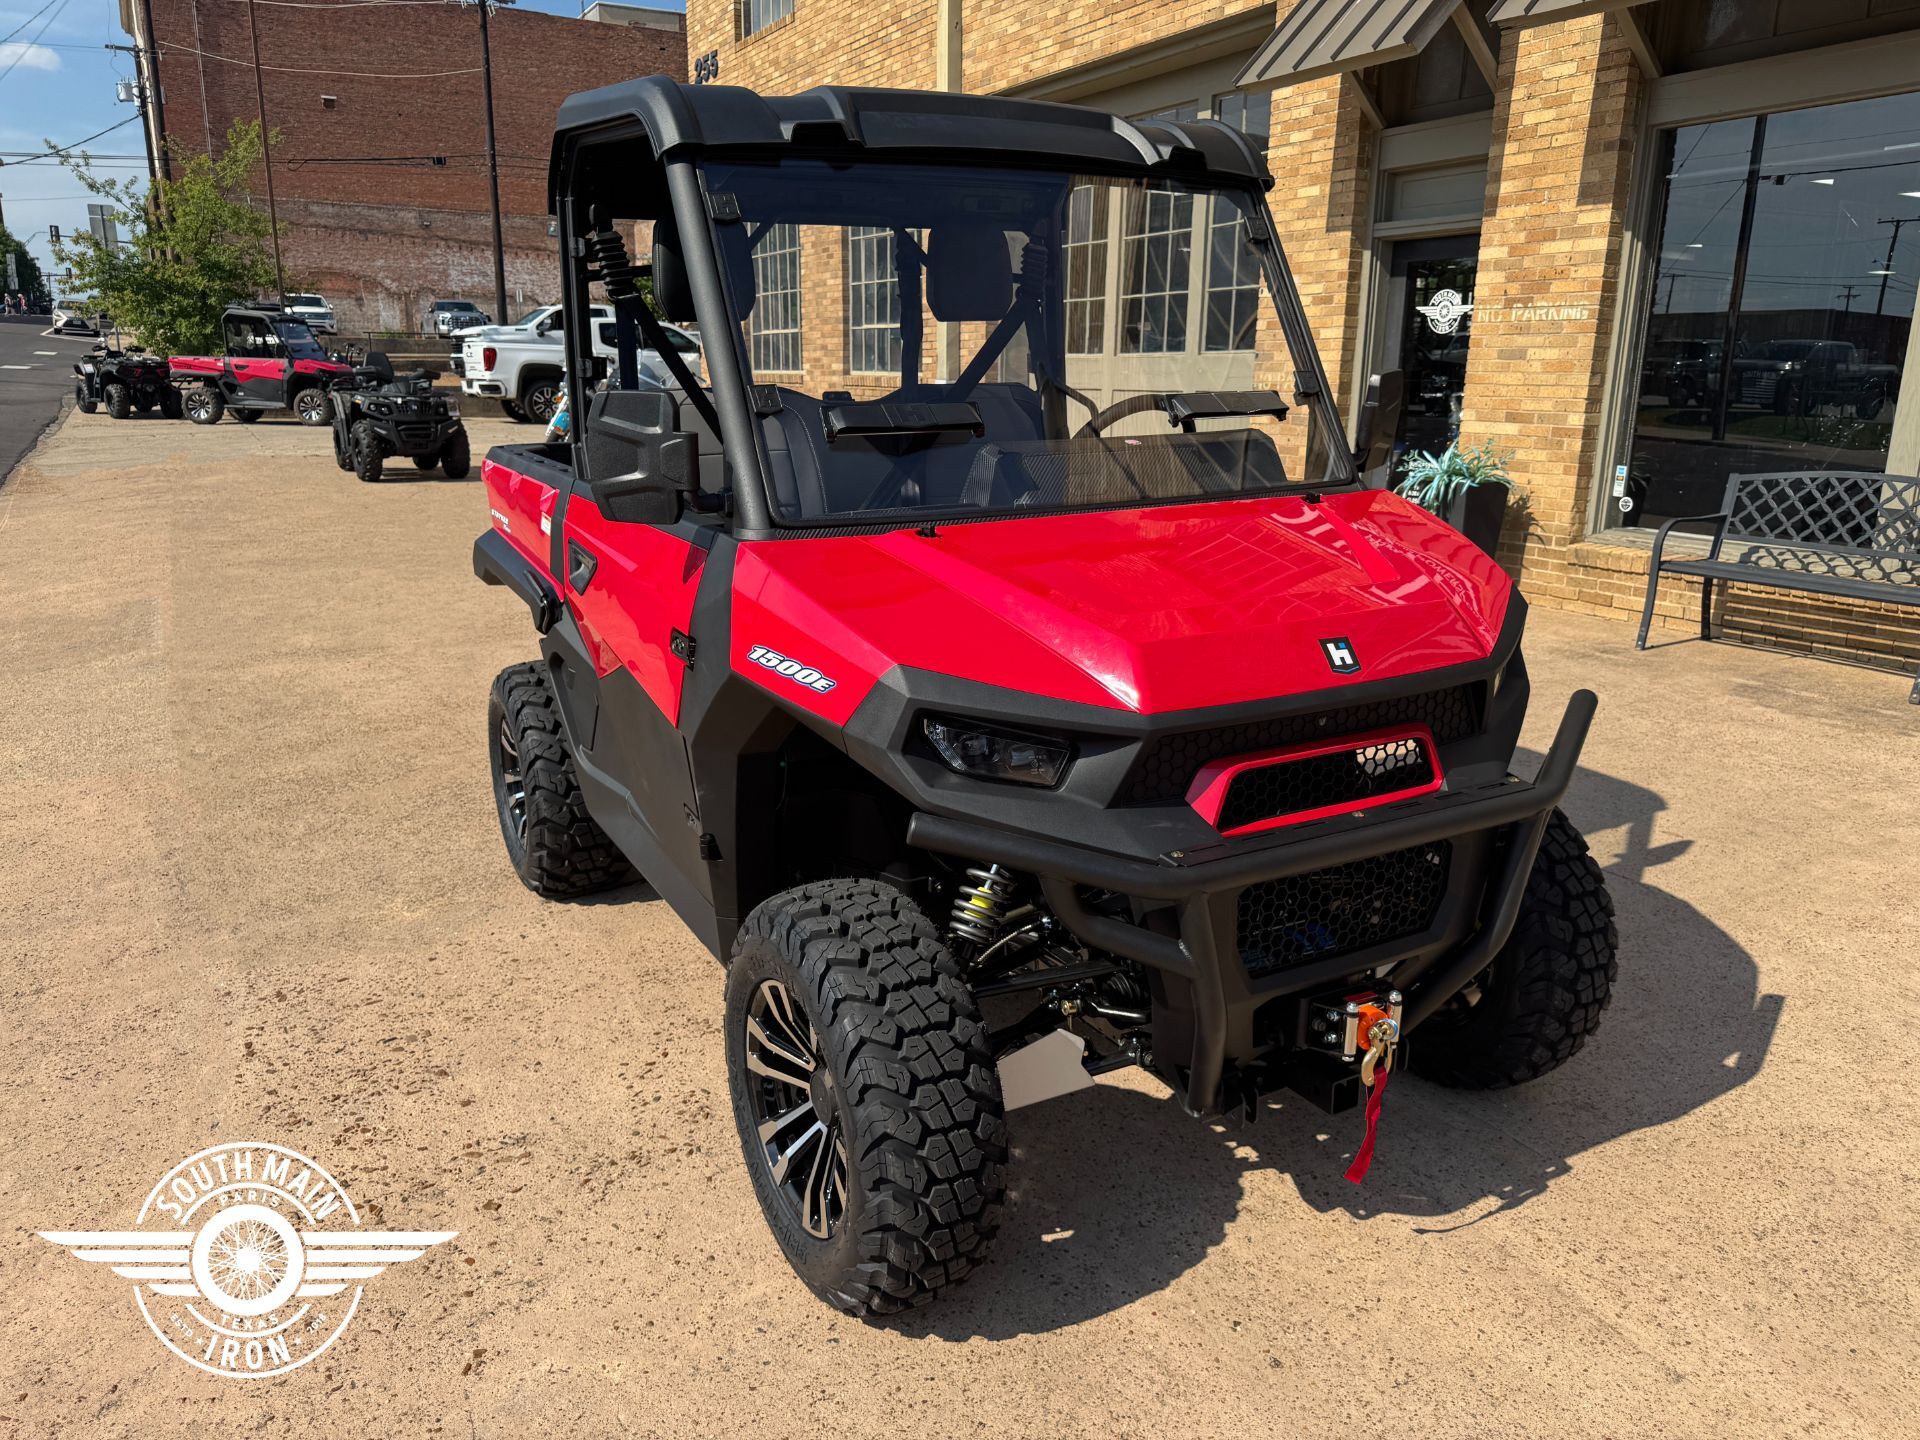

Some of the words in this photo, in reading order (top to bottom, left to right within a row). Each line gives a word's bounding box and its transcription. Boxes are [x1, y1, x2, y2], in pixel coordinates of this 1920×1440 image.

[694, 49, 718, 84] 255
[1478, 305, 1503, 323] NO
[1511, 301, 1590, 323] PARKING
[748, 645, 837, 693] 1500E
